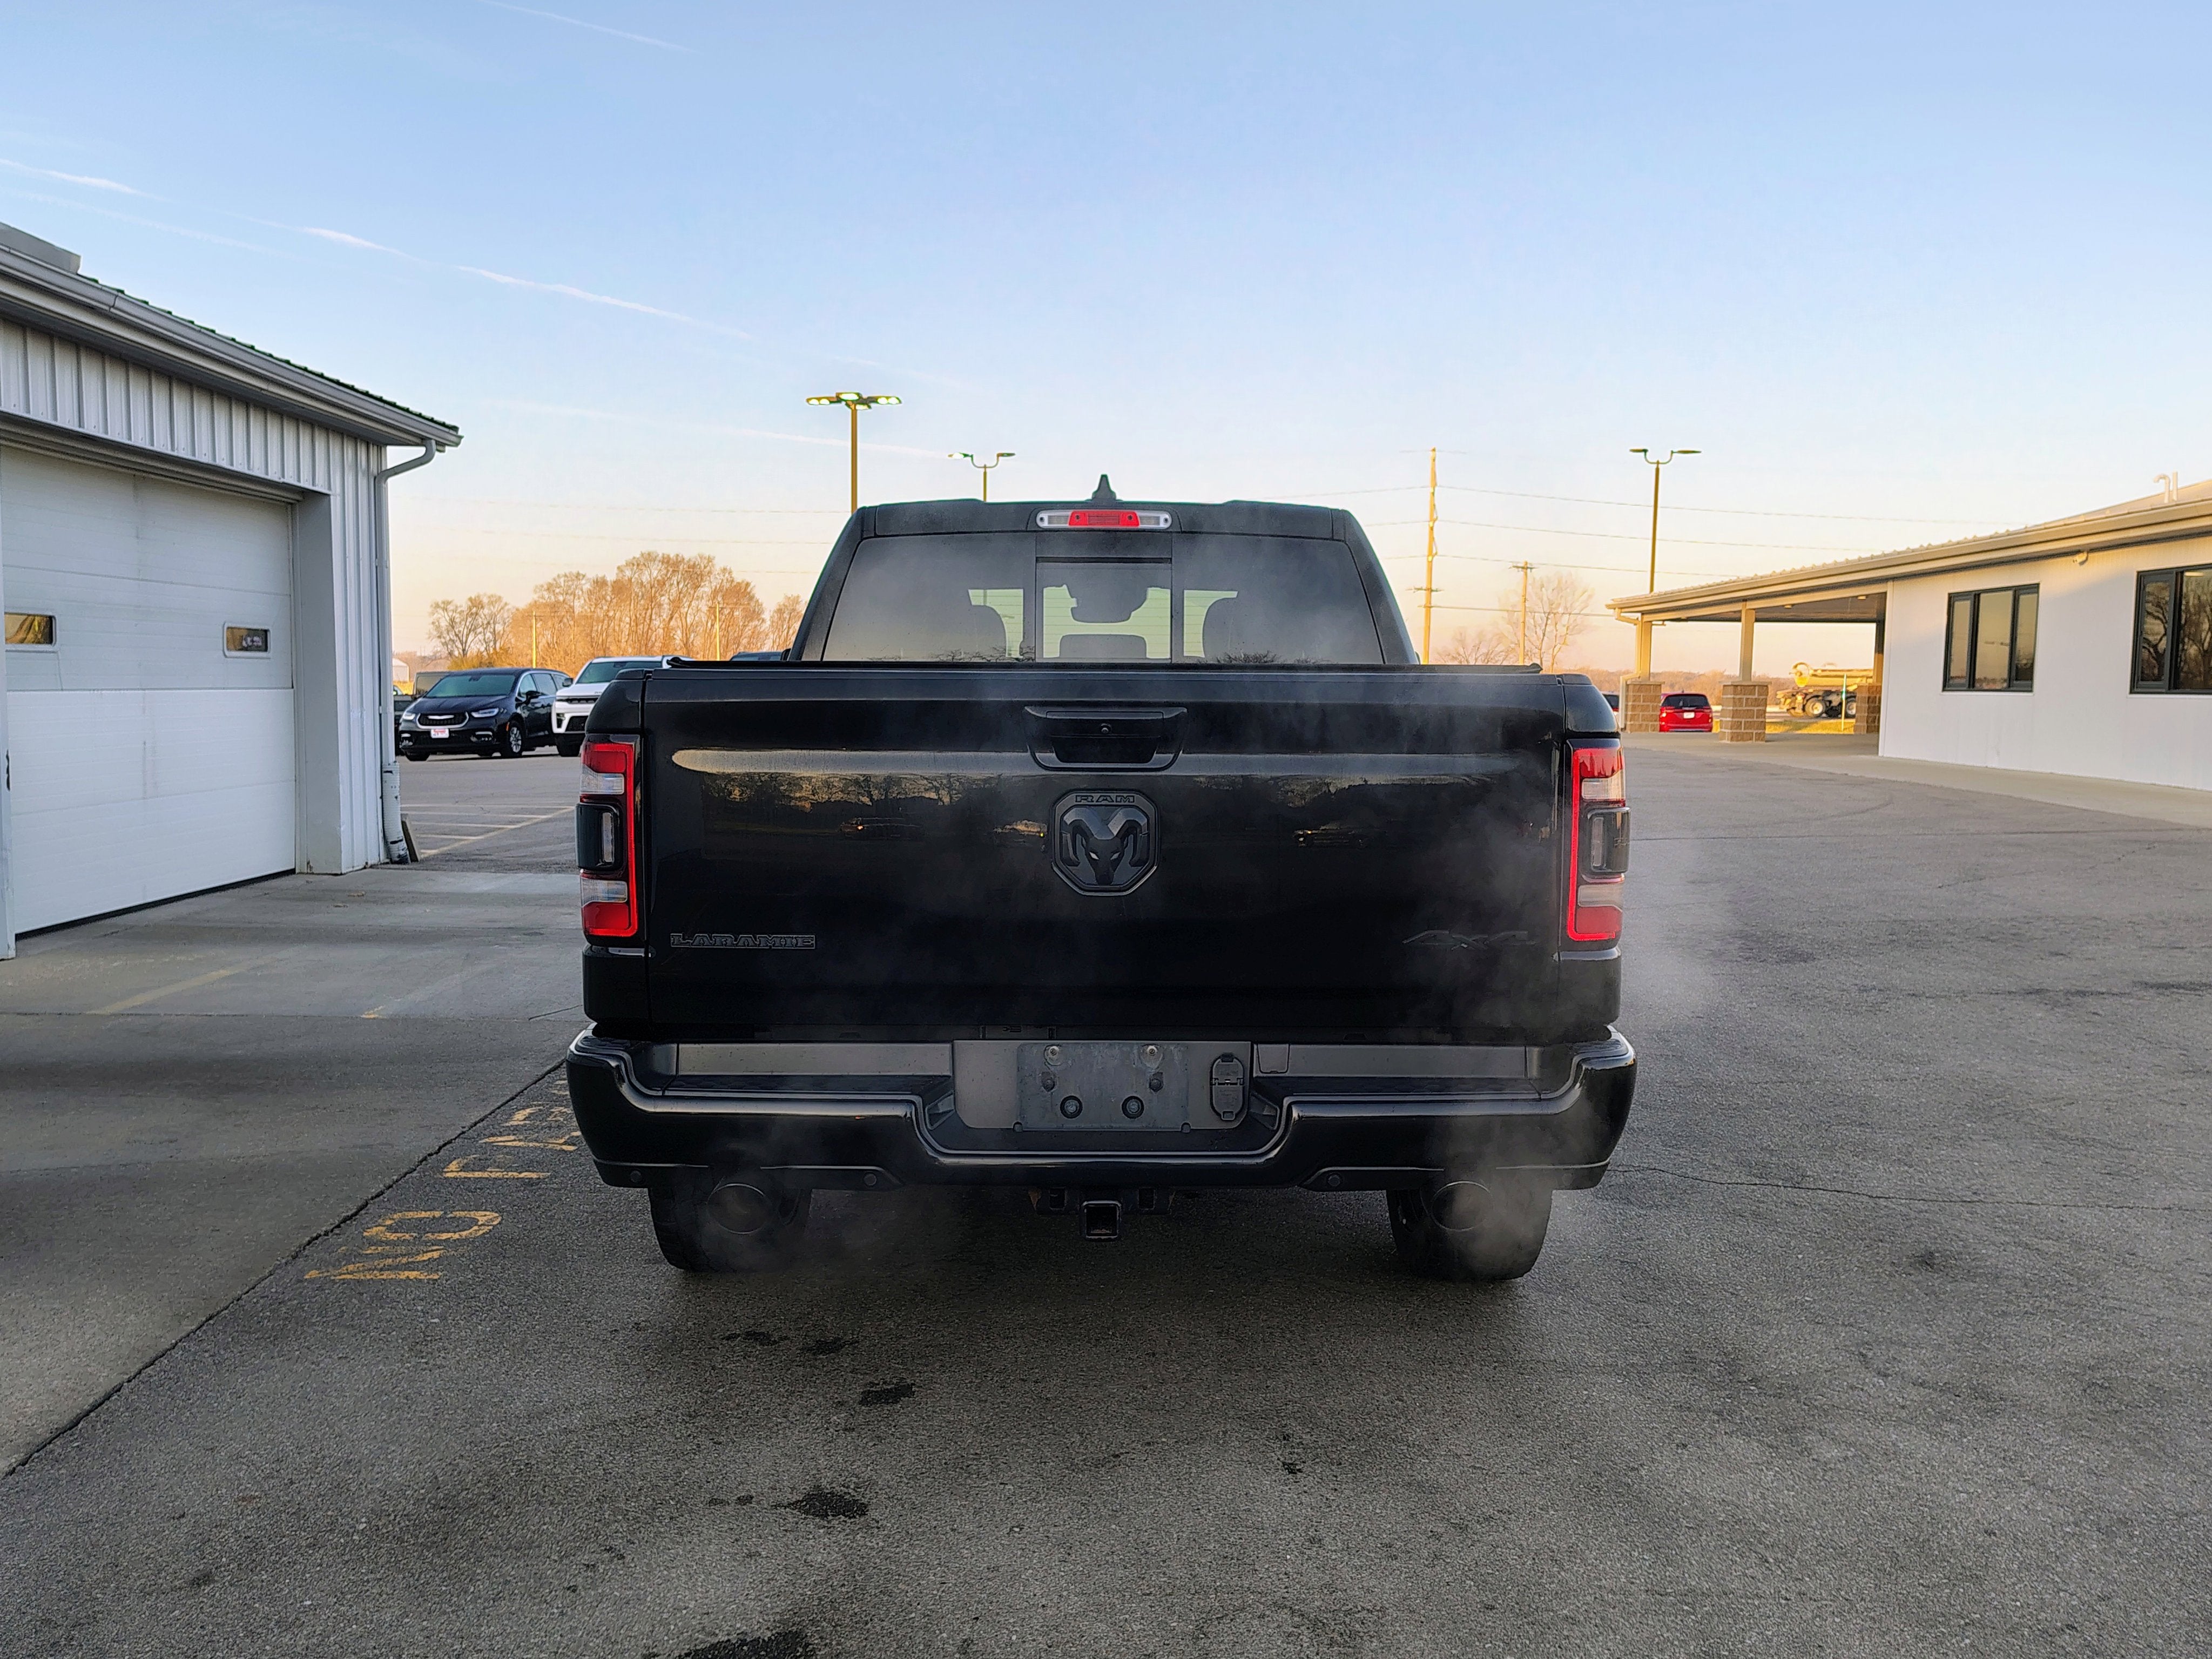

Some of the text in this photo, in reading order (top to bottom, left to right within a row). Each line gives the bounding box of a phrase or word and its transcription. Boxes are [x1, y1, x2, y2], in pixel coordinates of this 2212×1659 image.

[1075, 795, 1135, 803] RAM
[670, 933, 815, 949] LARAMIE
[304, 1210, 502, 1279] NO
